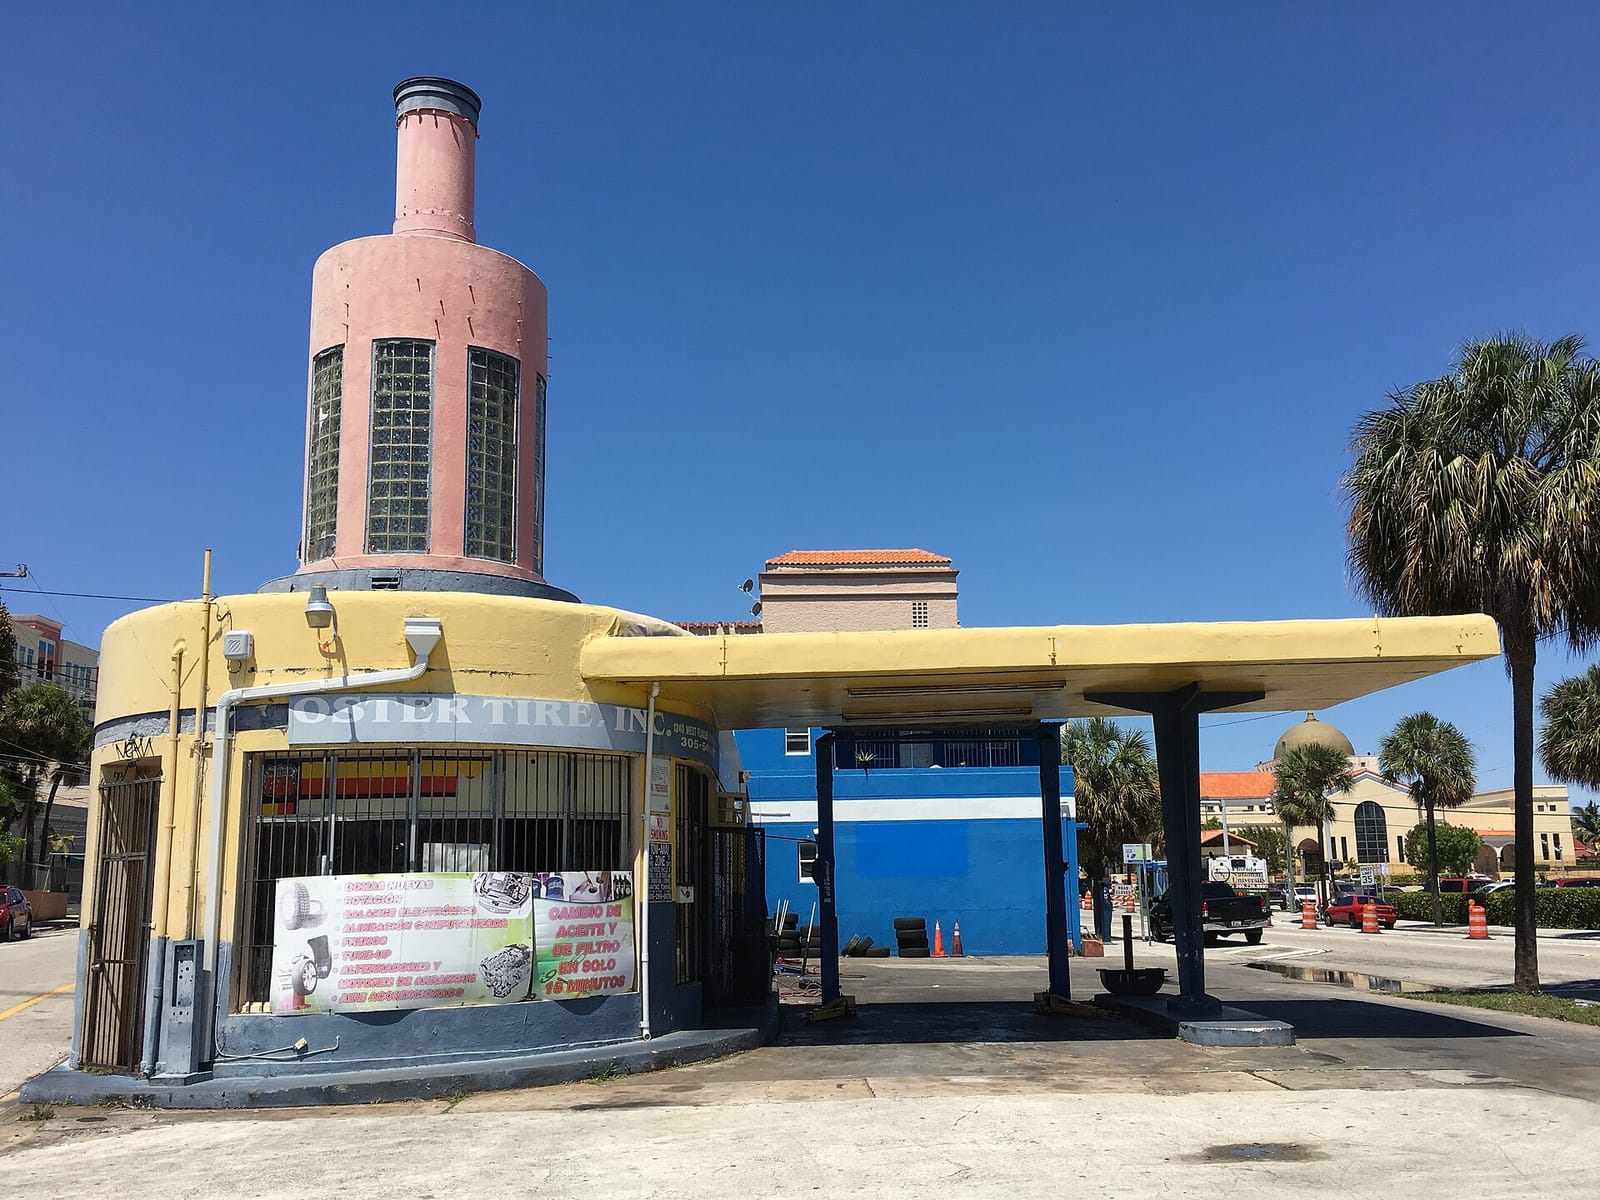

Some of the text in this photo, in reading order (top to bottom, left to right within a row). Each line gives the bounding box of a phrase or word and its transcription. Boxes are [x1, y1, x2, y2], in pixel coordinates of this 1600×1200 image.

[293, 696, 473, 723] OSTER
[614, 706, 672, 737] INC.
[386, 880, 435, 890] NUEVAS
[1362, 875, 1372, 883] 35
[549, 904, 622, 920] CAMBIO DE
[556, 922, 618, 938] ACEITE Y
[341, 949, 393, 960] TUNE-UP
[552, 940, 621, 957] DE FILTRO
[433, 961, 443, 971] Y
[558, 958, 617, 975] EN SOLO
[545, 975, 626, 994] 15 MINUTOS
